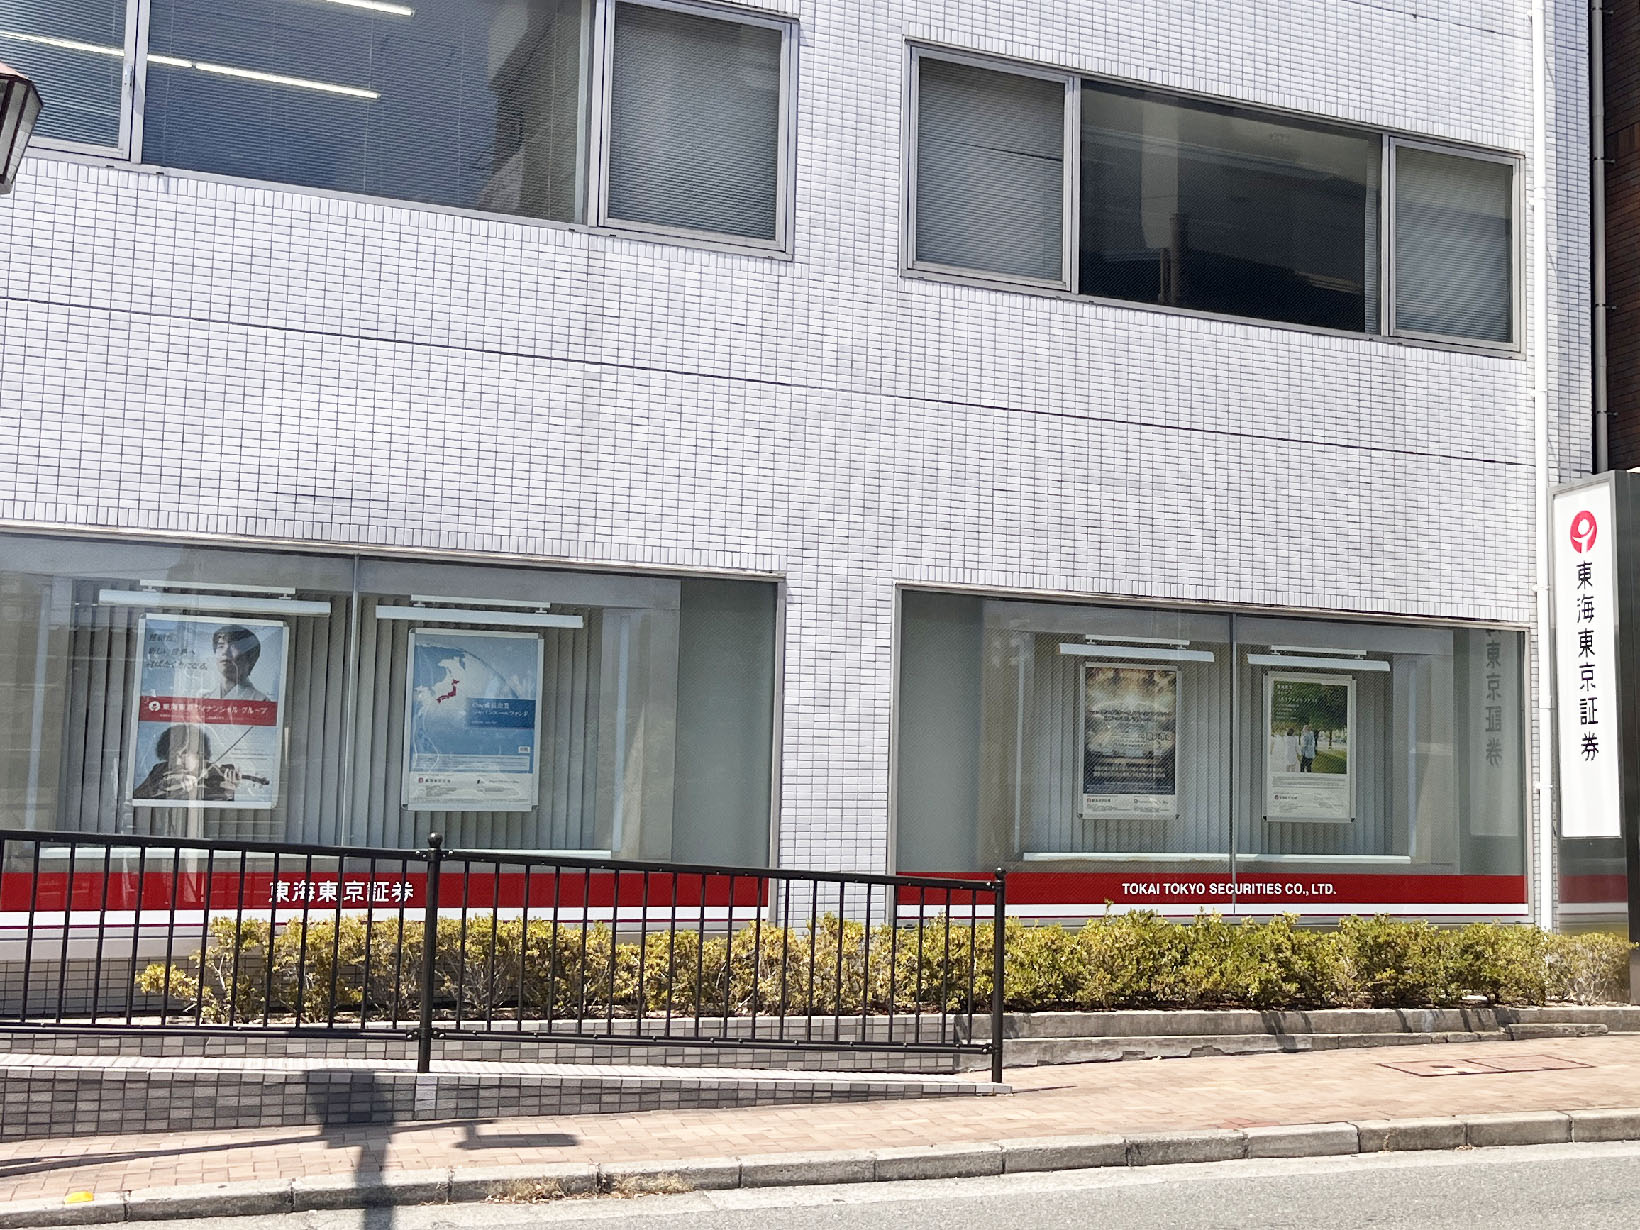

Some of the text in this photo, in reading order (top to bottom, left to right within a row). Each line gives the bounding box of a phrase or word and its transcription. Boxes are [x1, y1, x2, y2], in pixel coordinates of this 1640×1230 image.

[1576, 560, 1599, 761] 東海東京証券
[268, 879, 414, 903] 東海東京証券
[1122, 883, 1337, 897] TOKAI TOKYO SECURITIES CO., LTD.
